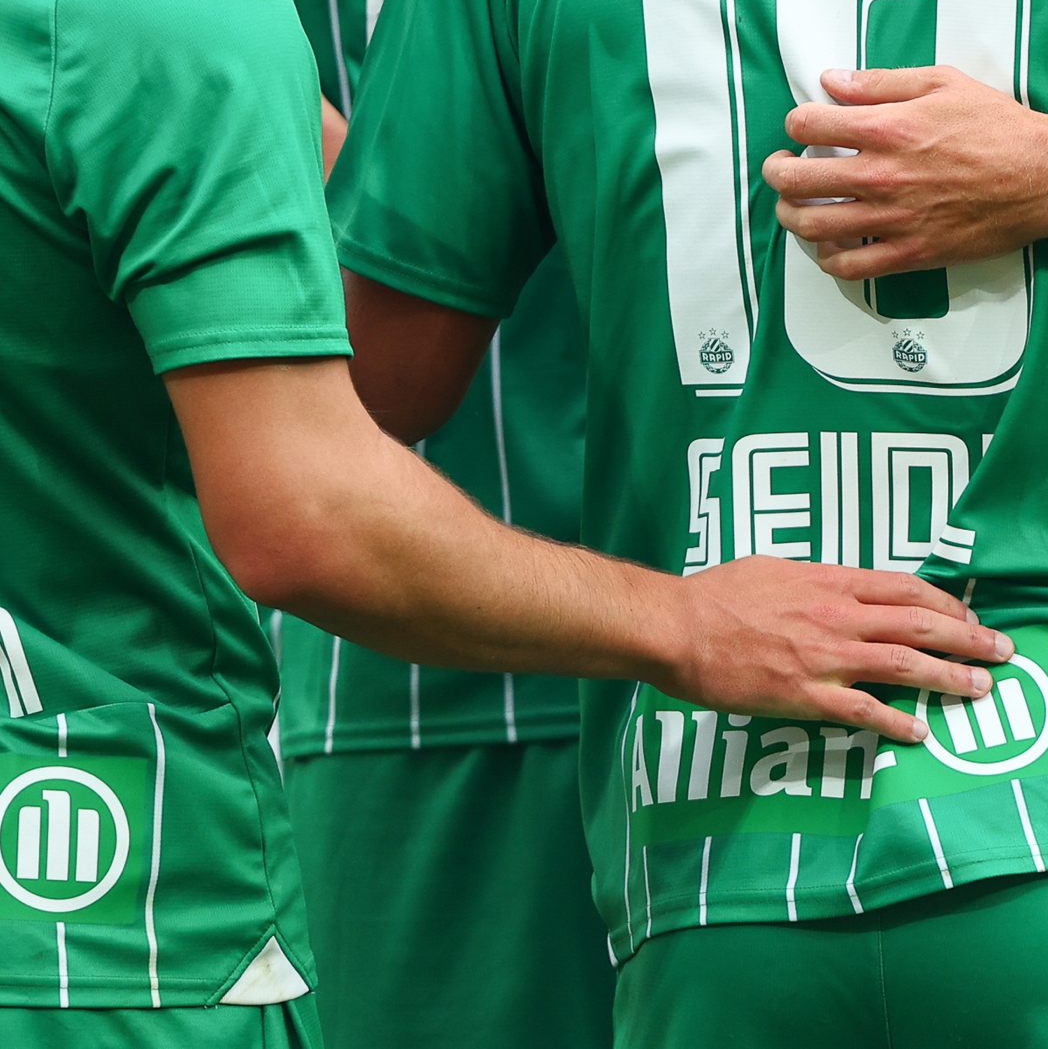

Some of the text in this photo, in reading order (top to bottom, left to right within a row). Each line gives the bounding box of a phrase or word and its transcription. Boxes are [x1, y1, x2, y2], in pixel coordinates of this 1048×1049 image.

[700, 351, 734, 363] RAPID
[895, 351, 926, 363] RAPID
[631, 710, 897, 814] Allian
